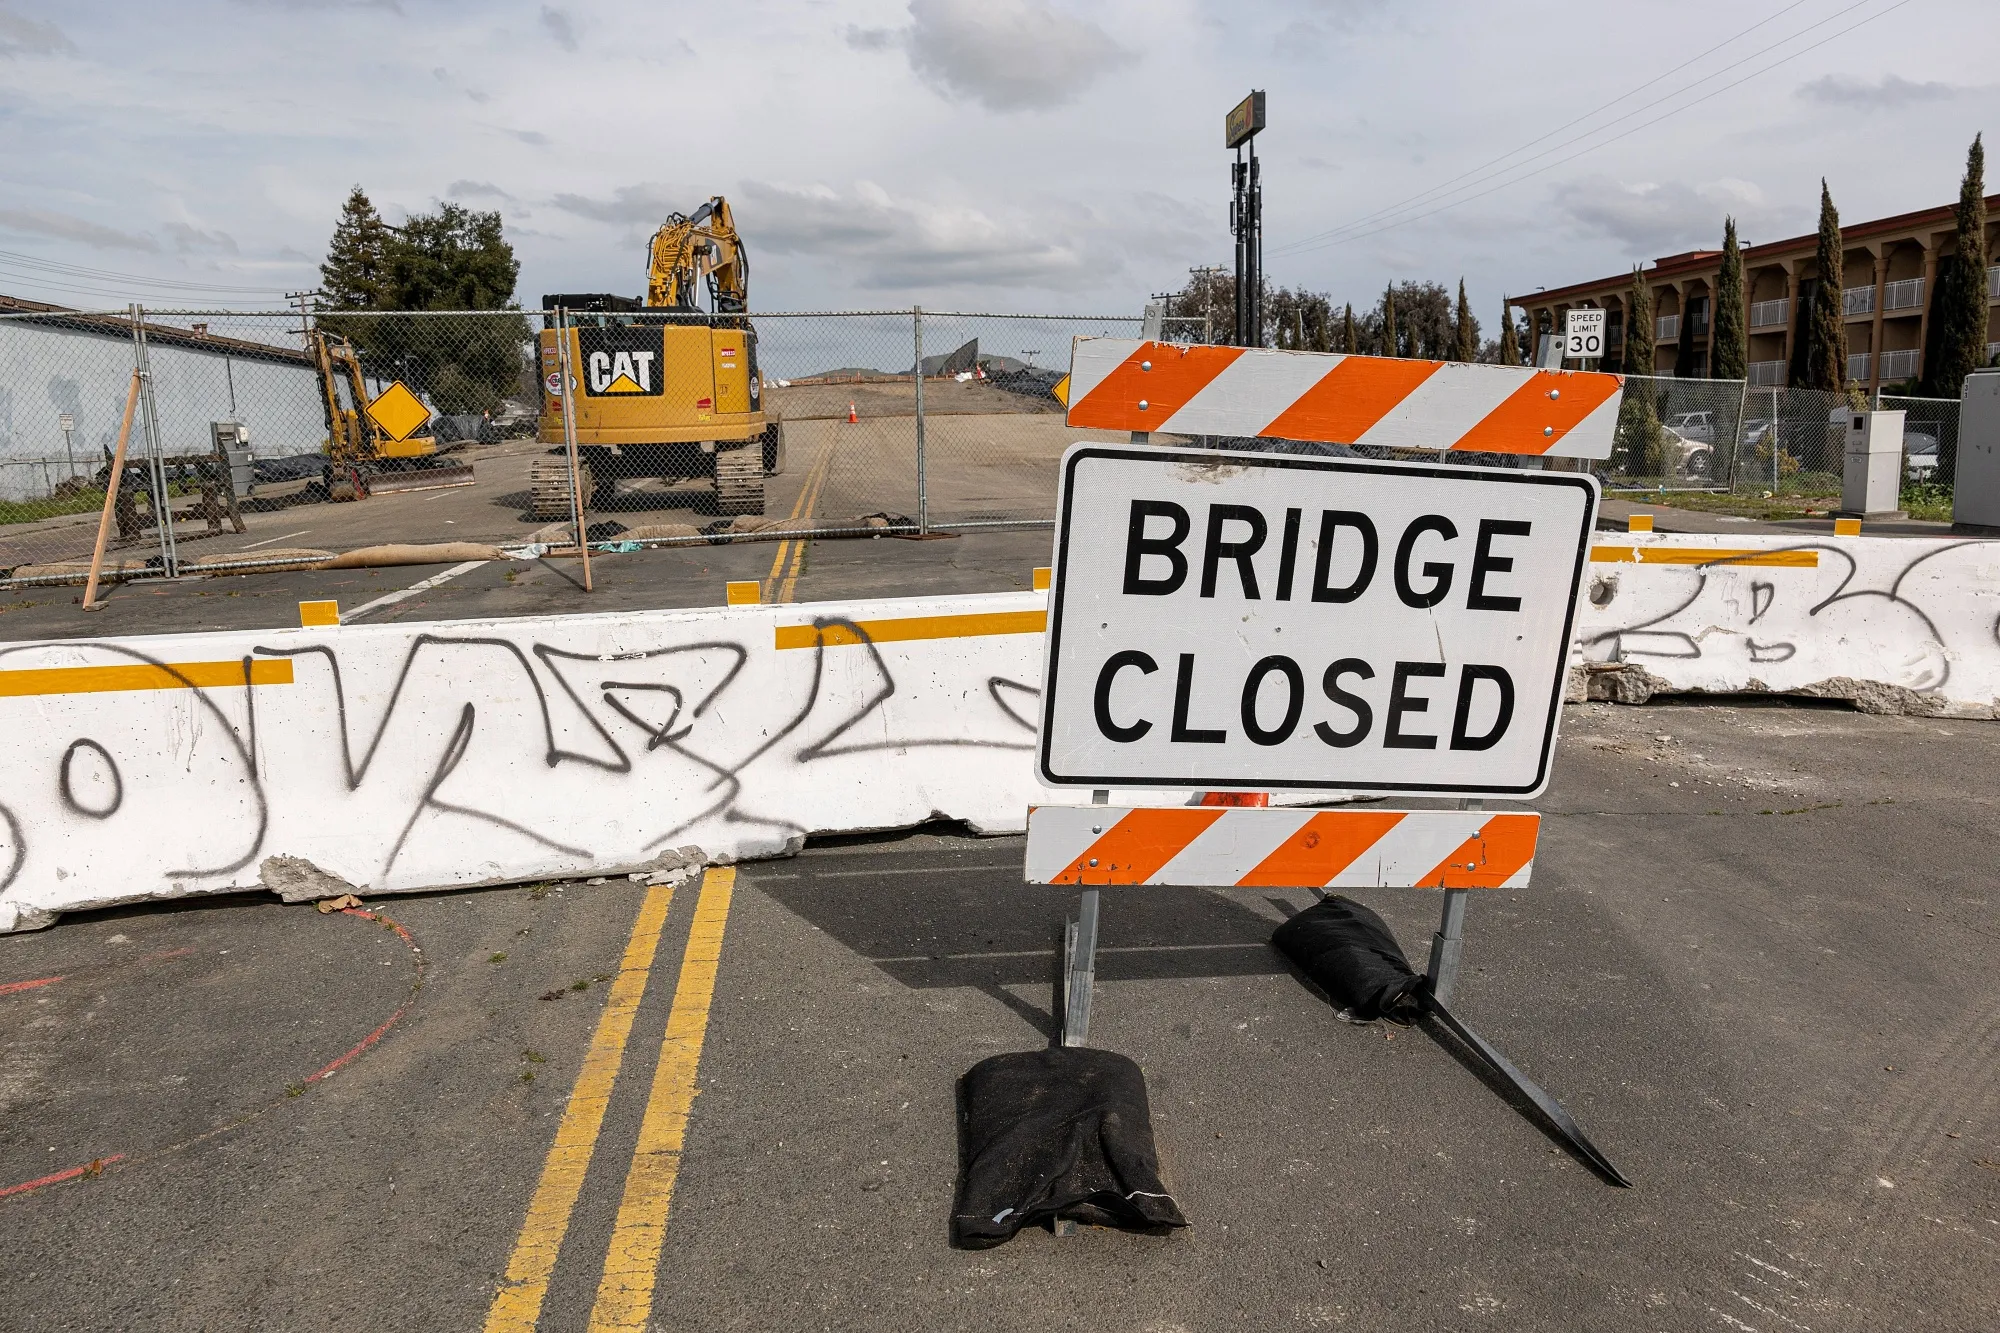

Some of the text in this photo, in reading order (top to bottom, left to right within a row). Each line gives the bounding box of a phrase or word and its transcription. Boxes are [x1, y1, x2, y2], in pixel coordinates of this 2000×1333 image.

[1570, 314, 1602, 322] SPEED
[1572, 324, 1598, 333] LIMIT
[1570, 335, 1600, 353] 30
[589, 351, 654, 393] CAT
[1122, 499, 1532, 612] BRIDGE
[1093, 650, 1516, 752] CLOSED
